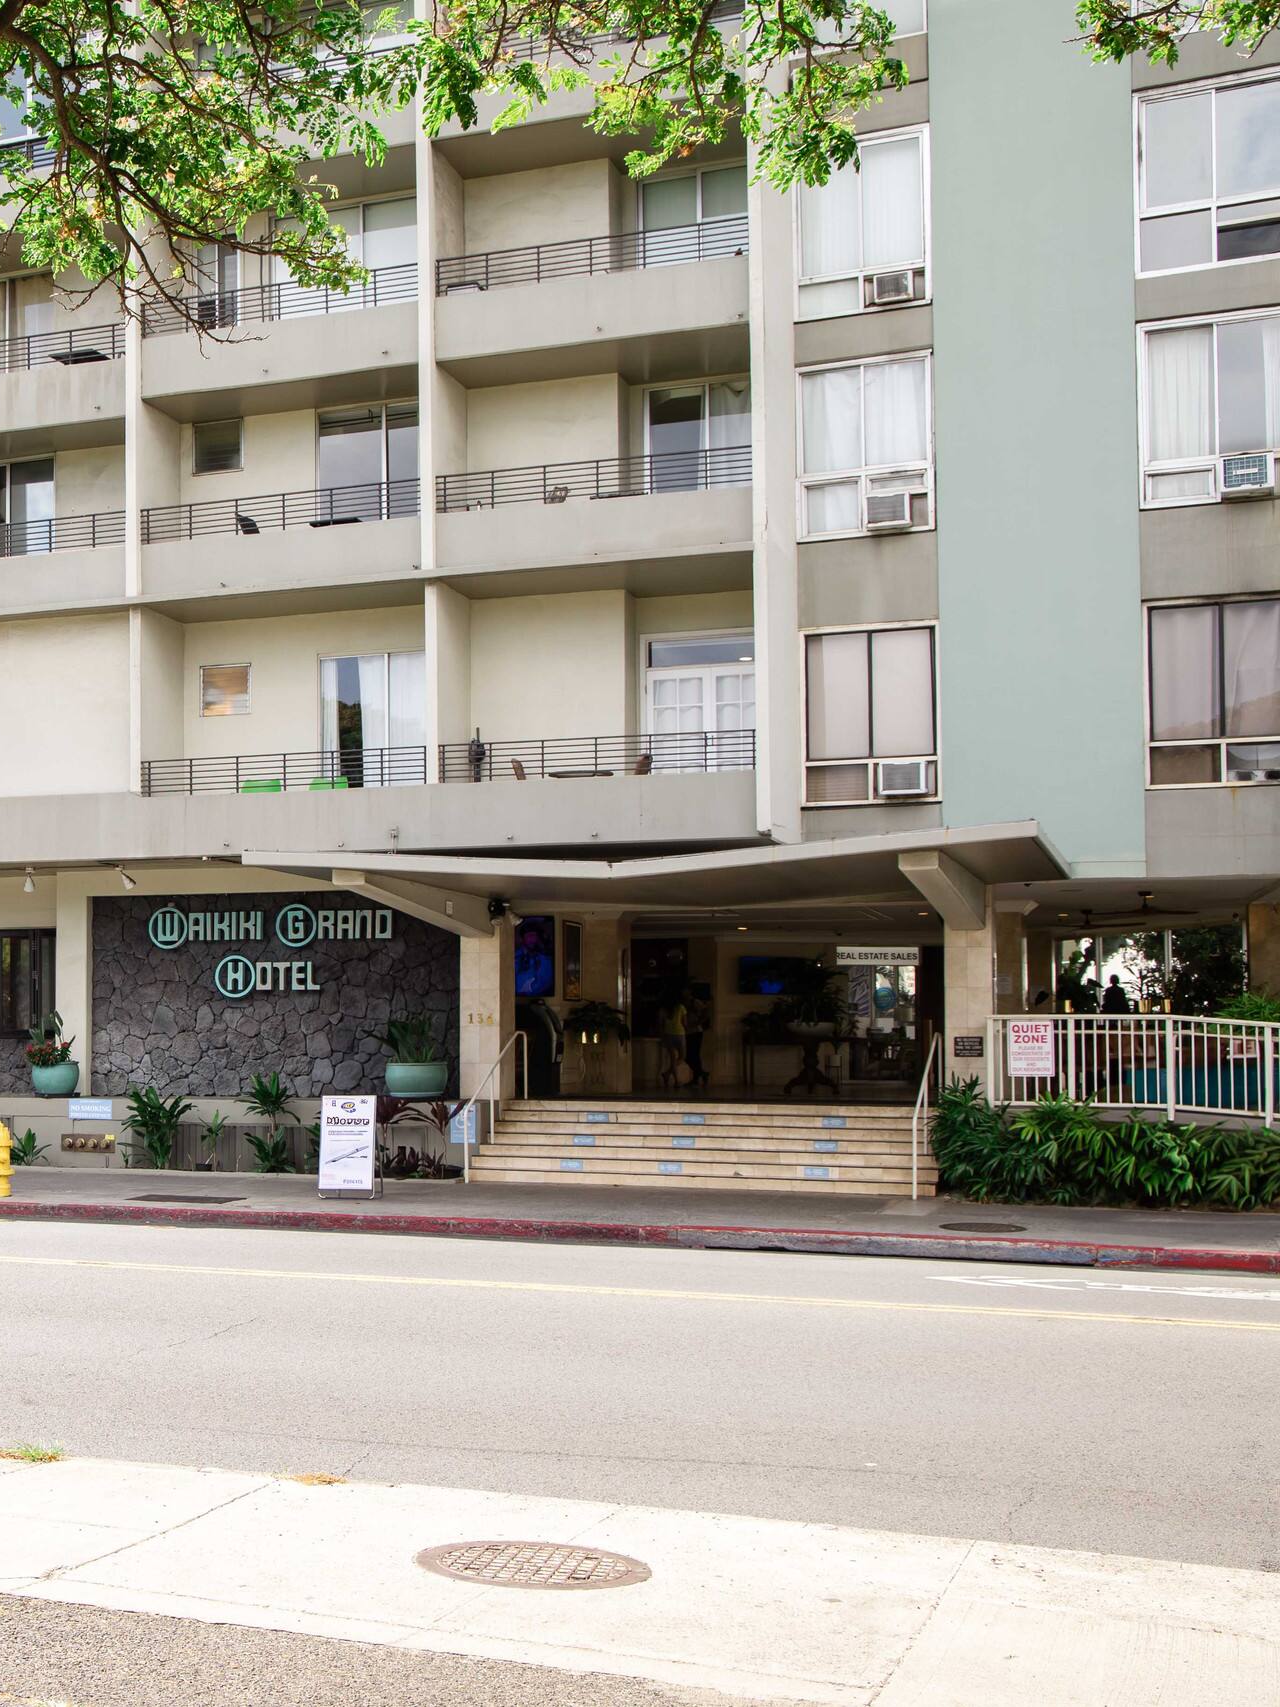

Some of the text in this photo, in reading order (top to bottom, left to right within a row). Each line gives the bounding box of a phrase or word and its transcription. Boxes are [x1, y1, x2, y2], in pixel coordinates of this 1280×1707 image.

[152, 906, 393, 946] WAIKIKI GRAND
[835, 952, 918, 960] REAL ESTATE SALES
[220, 957, 320, 994] HOTEL
[1012, 1024, 1050, 1034] QUIET
[1014, 1034, 1048, 1044] ZONE
